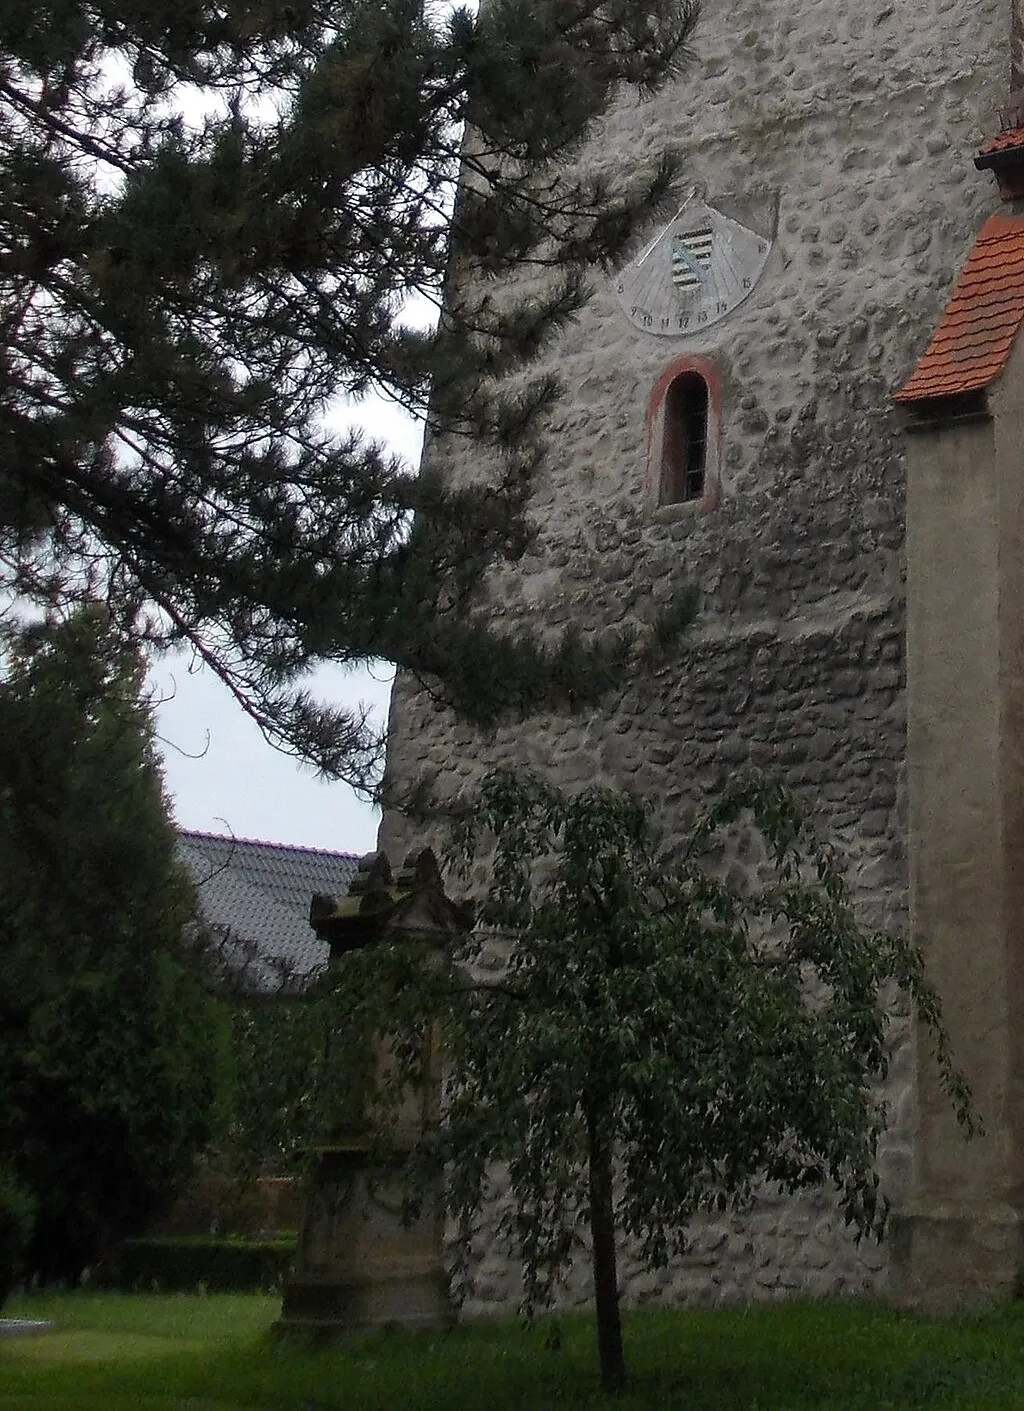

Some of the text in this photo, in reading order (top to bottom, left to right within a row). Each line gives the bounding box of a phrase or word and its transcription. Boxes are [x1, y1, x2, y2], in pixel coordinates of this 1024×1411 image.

[643, 316, 653, 327] 10
[698, 311, 708, 322] 13
[662, 318, 669, 328] 11
